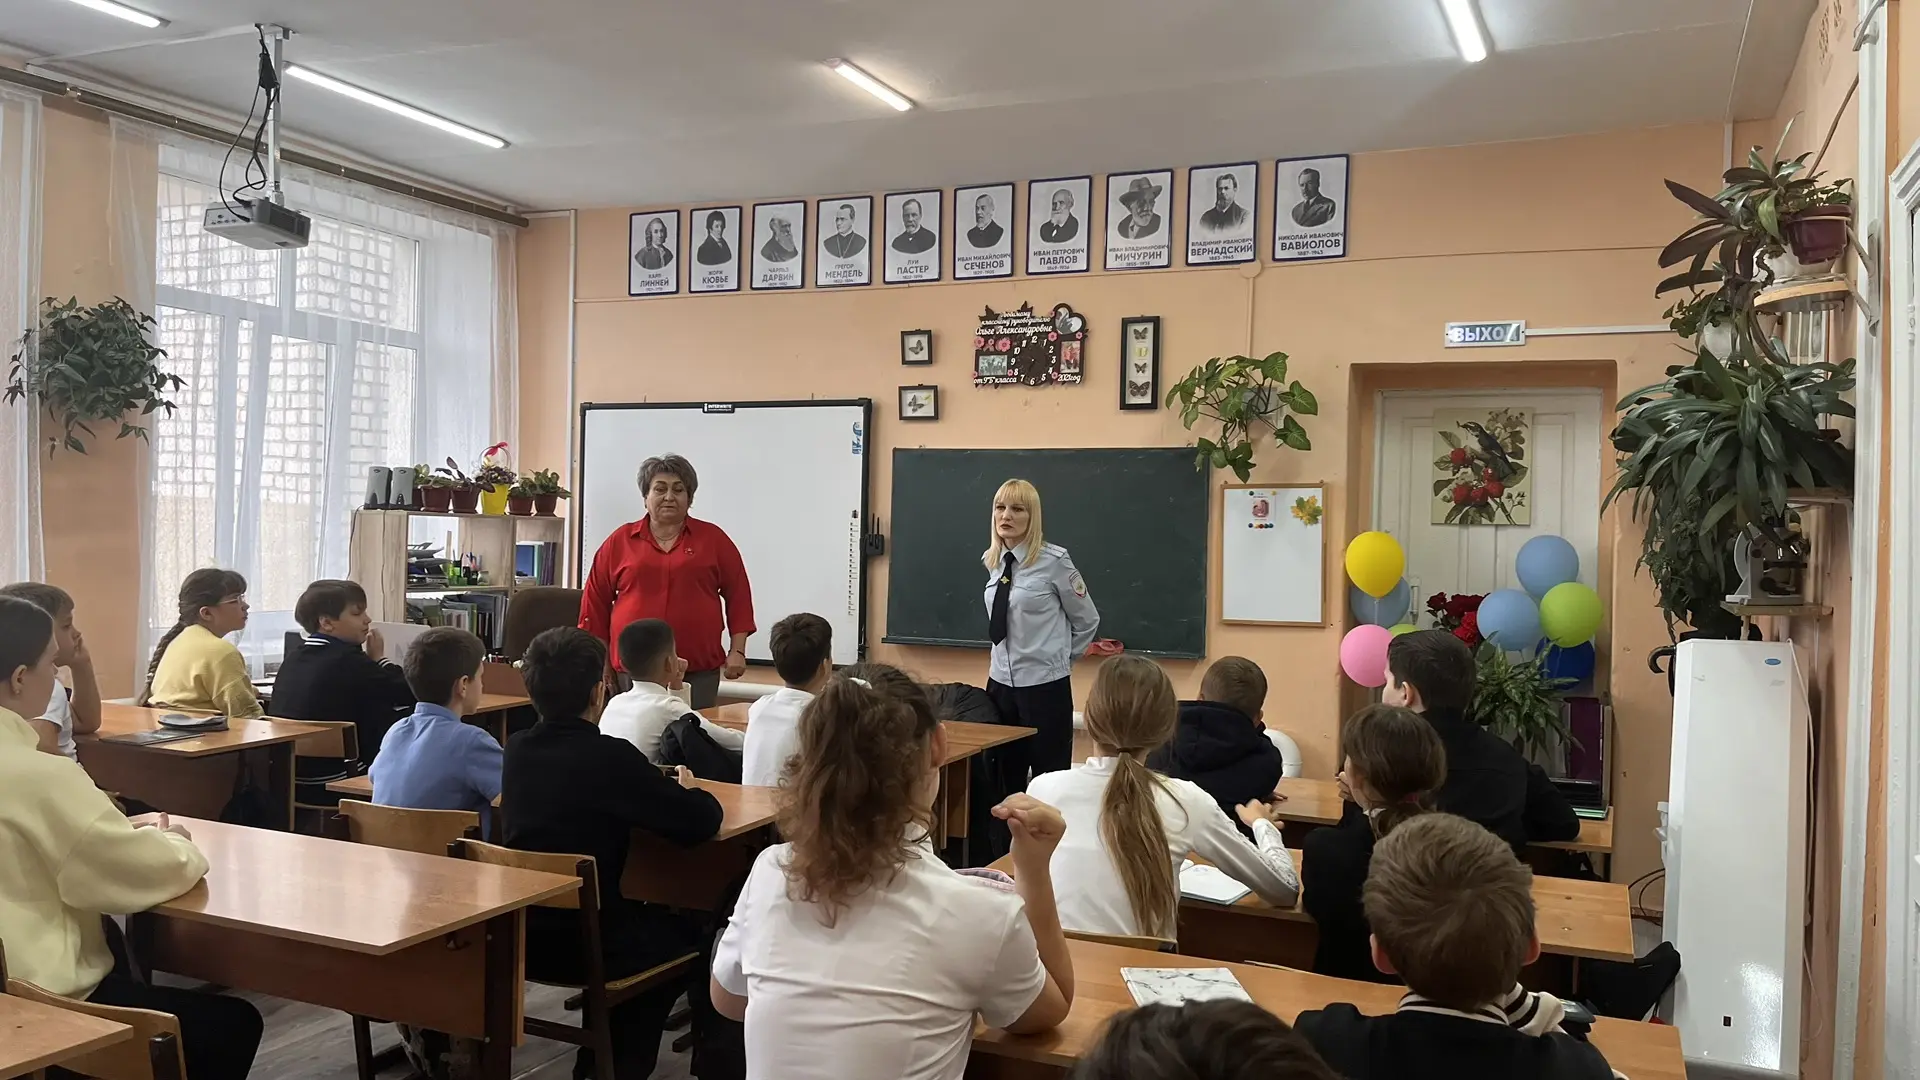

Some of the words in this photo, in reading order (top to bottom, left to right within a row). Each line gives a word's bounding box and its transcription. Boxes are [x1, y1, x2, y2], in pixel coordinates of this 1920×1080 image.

[1191, 243, 1253, 256] ВЕРНАДСКИЙ
[1281, 239, 1341, 251] ВАВИОЛОВ
[973, 253, 1011, 261] МИХАЙЛОВИЧ
[1039, 256, 1078, 265] ПАВЛОВ
[1115, 251, 1162, 261] МИЧУРИН
[897, 266, 929, 274] ПАСТЕР
[964, 260, 1004, 270] СЕЧЕНОВ
[762, 273, 793, 283] ДАРВИН
[825, 270, 863, 278] МЕНДЕЛЬ
[640, 277, 669, 287] ЛИННЕЙ
[702, 276, 728, 284] КЮВЬЕ
[975, 326, 995, 335] Ольге
[996, 323, 1053, 337] Александровне
